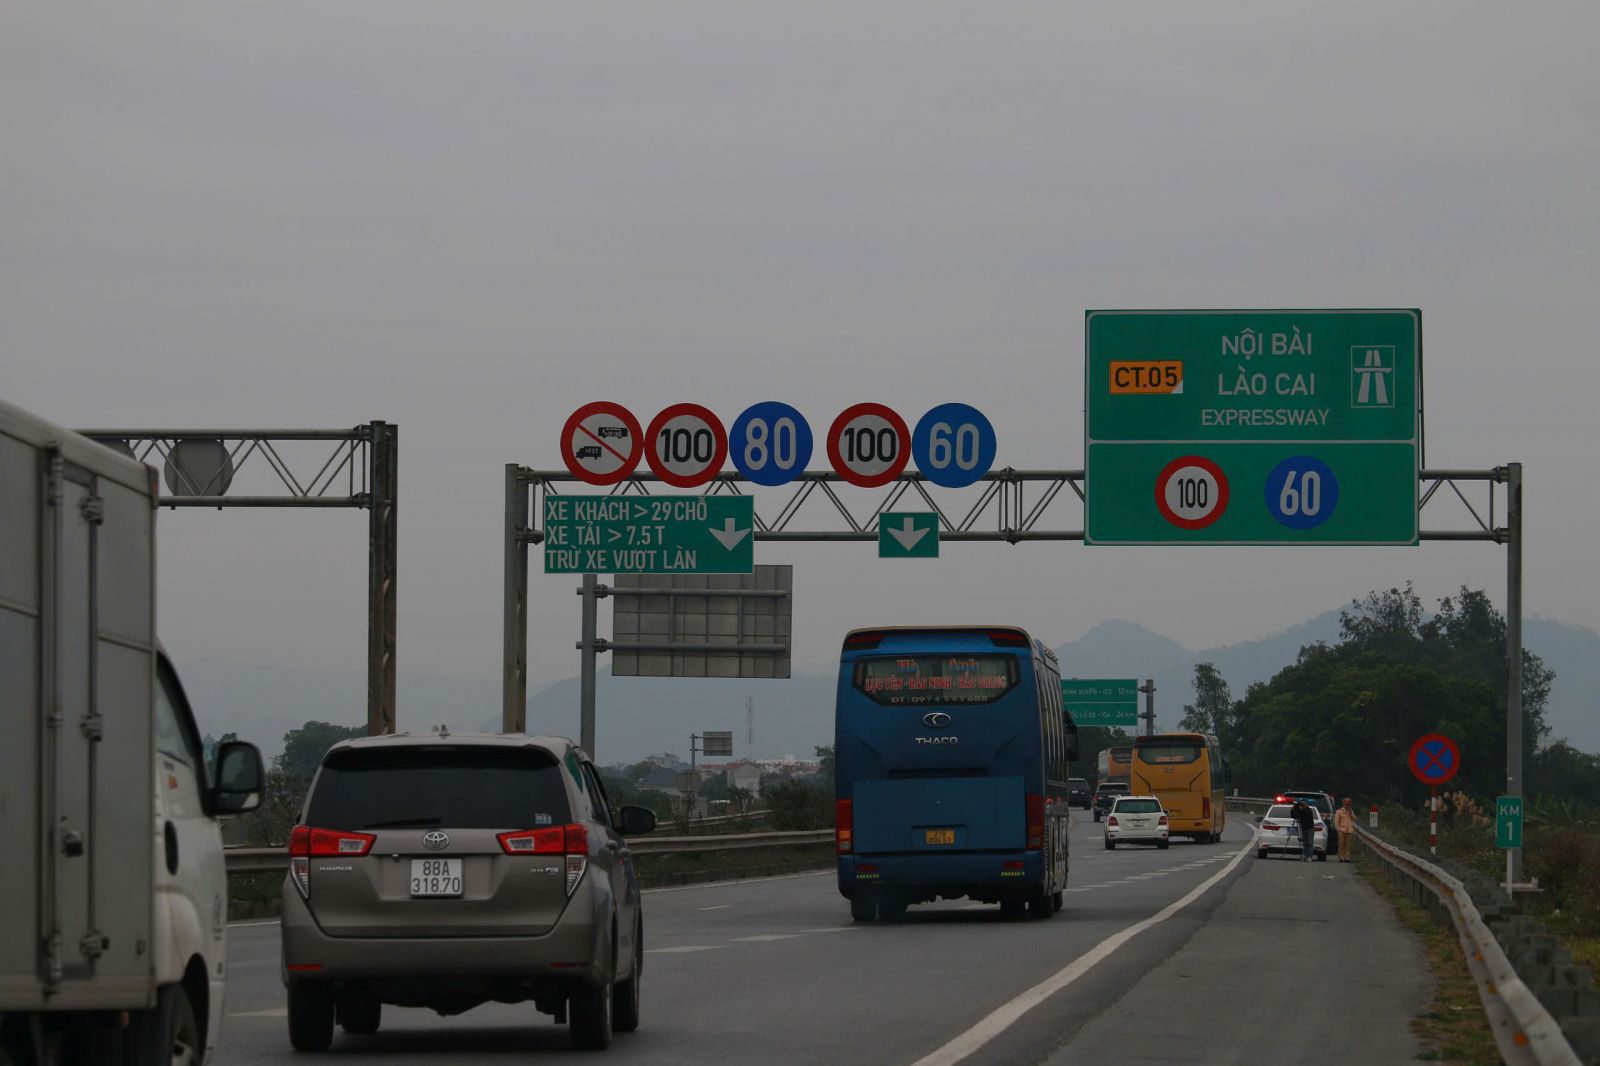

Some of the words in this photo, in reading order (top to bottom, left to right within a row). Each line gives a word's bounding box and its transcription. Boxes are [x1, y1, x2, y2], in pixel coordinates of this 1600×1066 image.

[1221, 327, 1263, 360] NỘI
[1272, 324, 1312, 355] BÀI
[1114, 366, 1178, 389] CT.05
[1218, 364, 1268, 396] LÀO
[1274, 372, 1315, 396] CAI
[1201, 409, 1330, 427] EXPRESSWAY
[660, 428, 714, 463] 100
[744, 416, 797, 471] 80
[844, 427, 898, 463] 100
[928, 421, 980, 470] 60
[1177, 478, 1208, 509] 100
[1279, 470, 1321, 517] 60
[546, 501, 569, 521] XE
[574, 497, 630, 521] KHÁCH
[546, 525, 569, 545] XE
[575, 521, 601, 545] TẢI
[626, 525, 651, 546] 7.5
[653, 525, 666, 545] T
[546, 546, 581, 570] TRỪ
[586, 550, 607, 570] XE
[613, 548, 658, 573] VƯỢT
[663, 546, 697, 570] LÀN
[914, 736, 958, 745] THACO
[1500, 804, 1520, 816] KM
[1506, 821, 1514, 841] 1
[423, 860, 450, 876] 88A
[412, 877, 462, 894] 318.70
